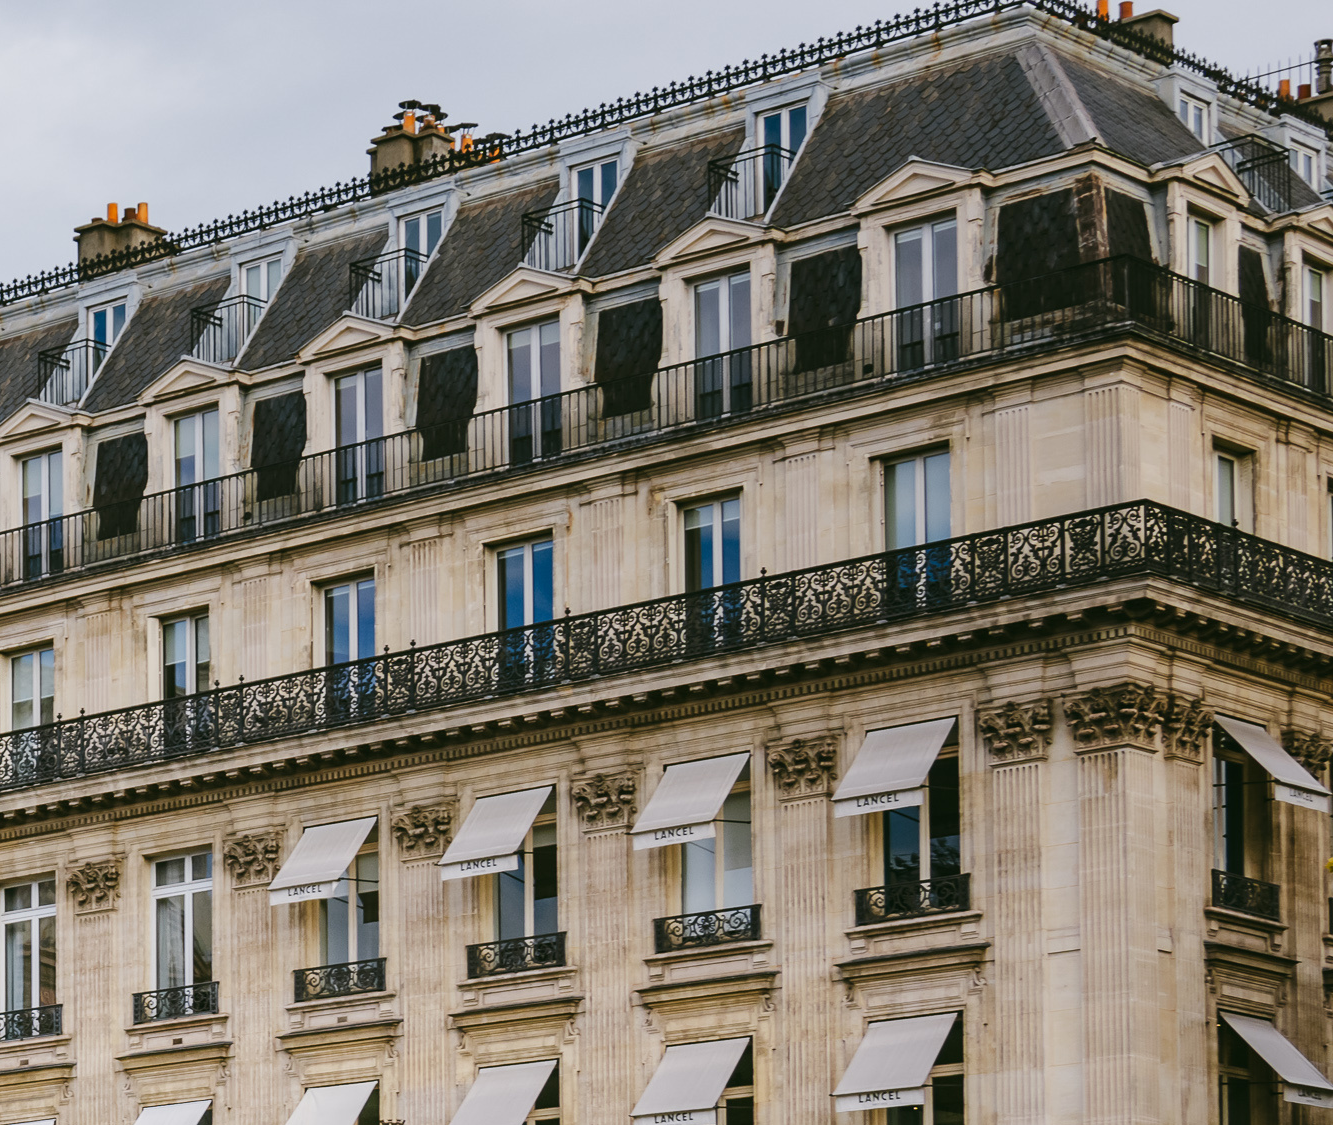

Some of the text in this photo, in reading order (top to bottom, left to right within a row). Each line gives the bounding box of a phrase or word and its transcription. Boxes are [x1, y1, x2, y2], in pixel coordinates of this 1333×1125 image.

[856, 792, 900, 808] LANCEL
[654, 826, 694, 840] LANCEL
[460, 858, 498, 872] LANCEL
[288, 884, 322, 897] LANCEL
[858, 1090, 902, 1103] LANCEL
[654, 1112, 694, 1124] LANCEL
